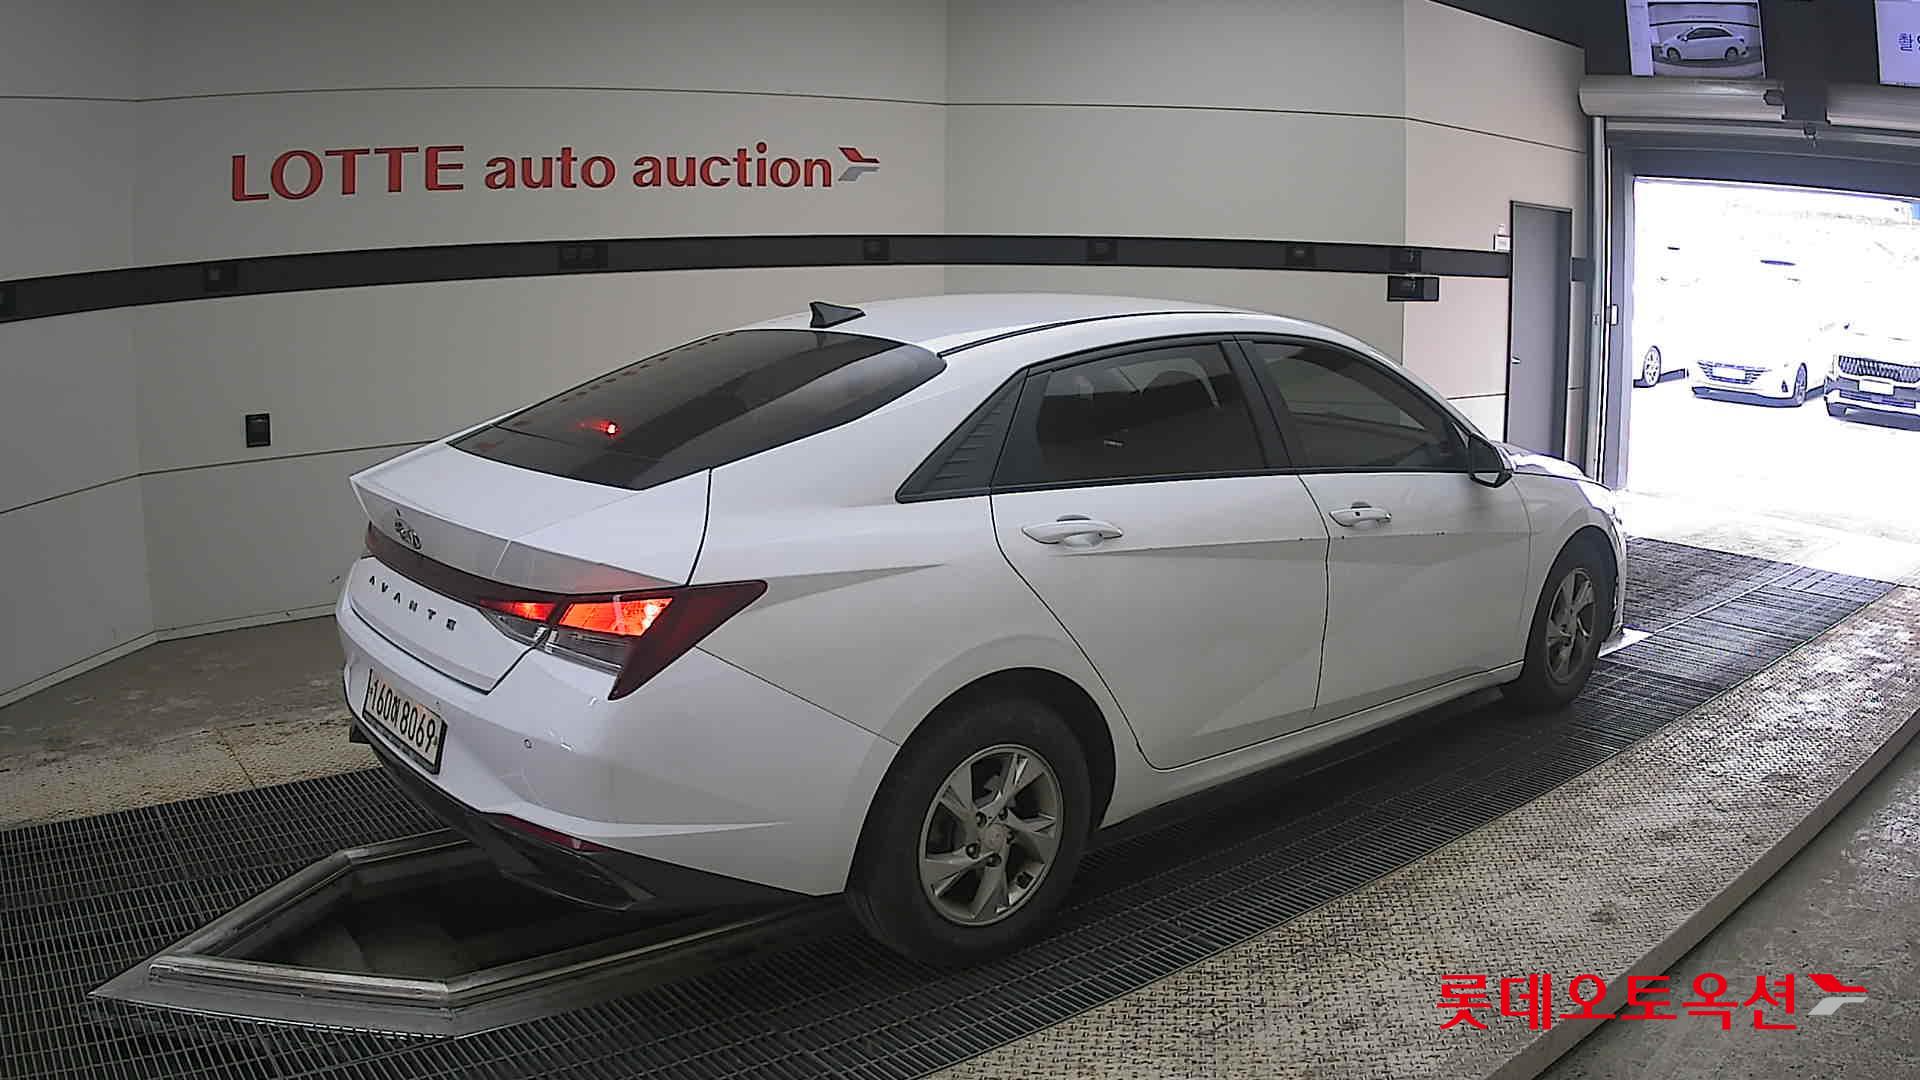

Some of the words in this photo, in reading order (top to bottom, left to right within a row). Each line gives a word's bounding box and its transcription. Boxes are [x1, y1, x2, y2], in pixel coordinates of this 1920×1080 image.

[232, 145, 465, 202] LOTTE
[484, 146, 617, 189] auto
[632, 141, 833, 188] auction
